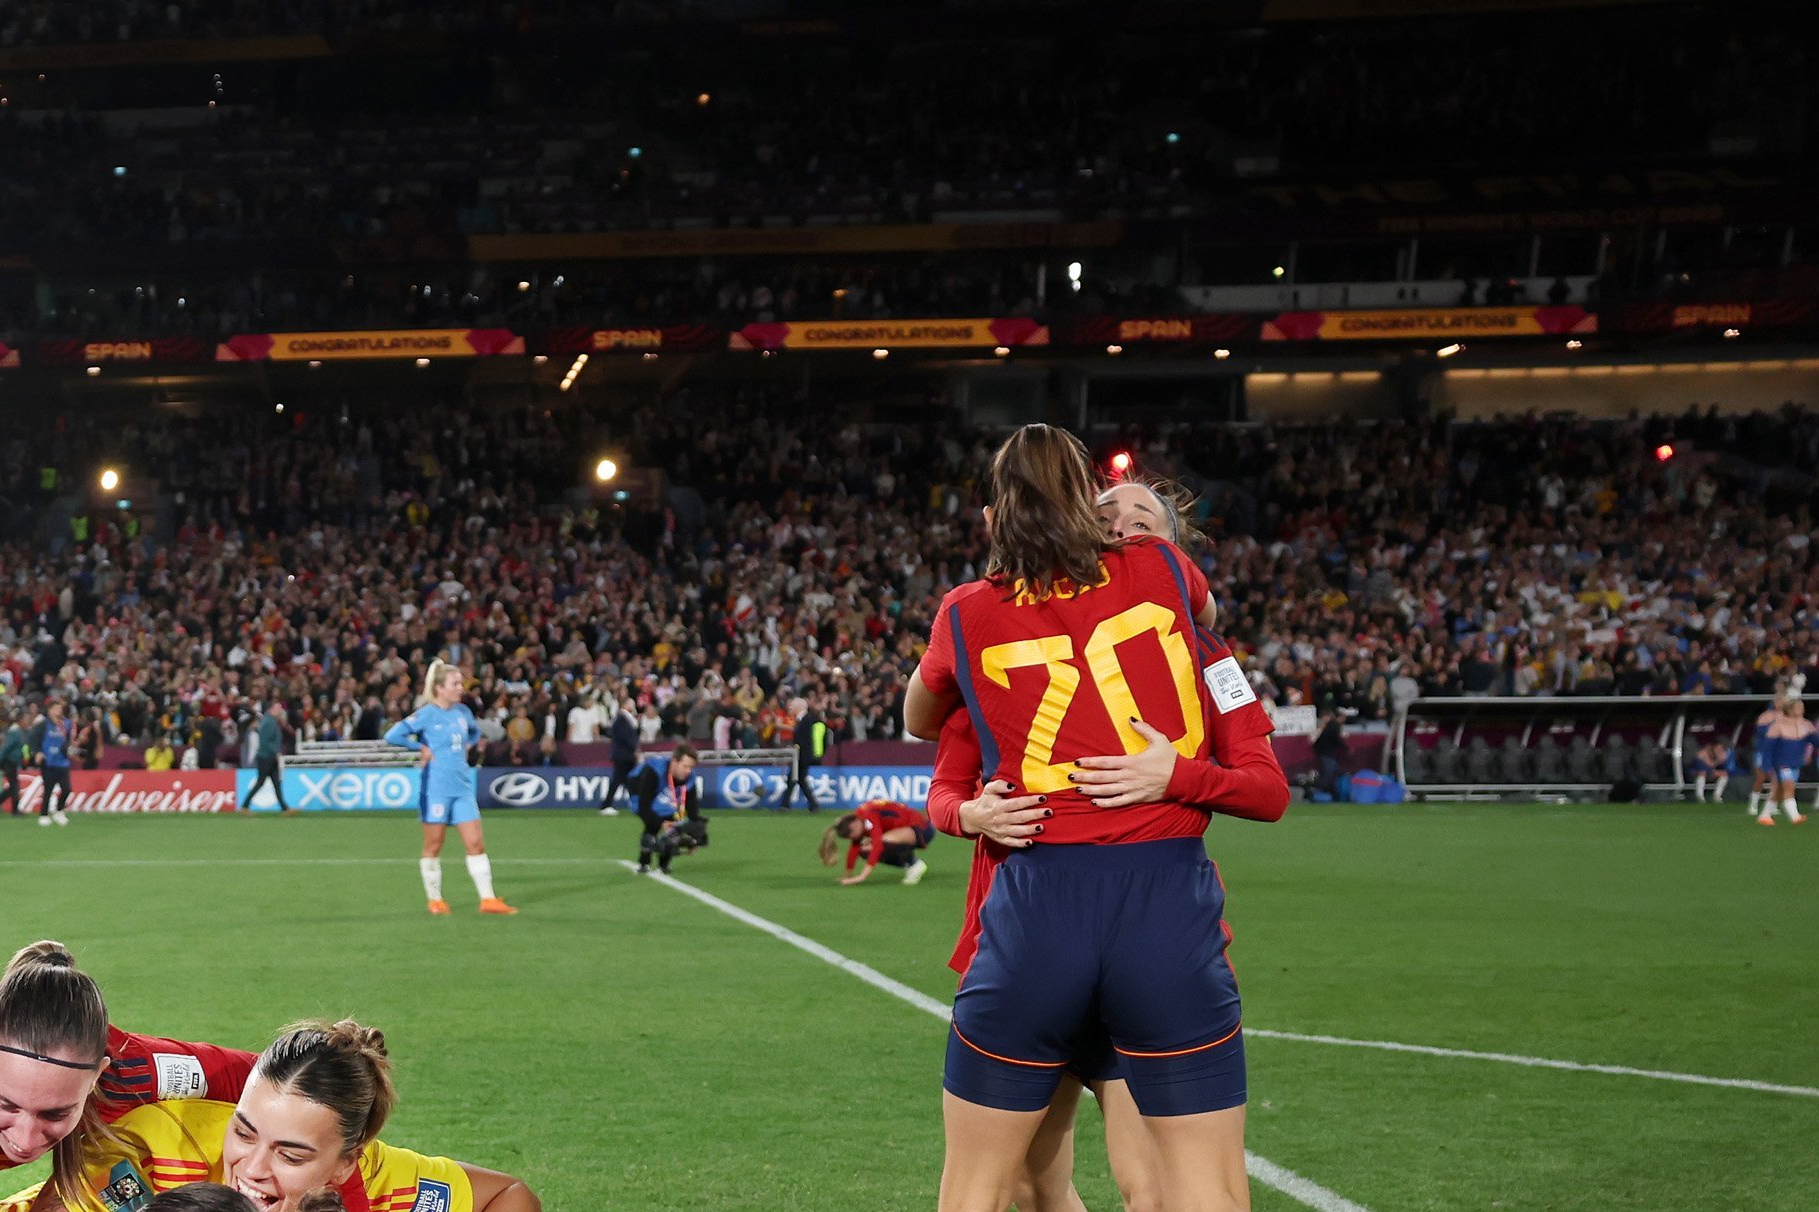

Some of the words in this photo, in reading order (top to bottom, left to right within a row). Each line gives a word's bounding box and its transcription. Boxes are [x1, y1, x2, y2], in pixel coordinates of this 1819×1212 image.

[1341, 314, 1518, 332] CONGRATULATIONS
[1674, 304, 1750, 326] SPAIN
[805, 326, 974, 342] CONGRATULATIONS
[1120, 320, 1191, 338] SPAIN
[288, 336, 451, 351] CONGRATULATIONS
[593, 329, 662, 348] SPAIN
[85, 343, 152, 360] SPAIN
[981, 601, 1204, 794] 20
[300, 772, 413, 809] xero
[837, 774, 932, 802] WAND
